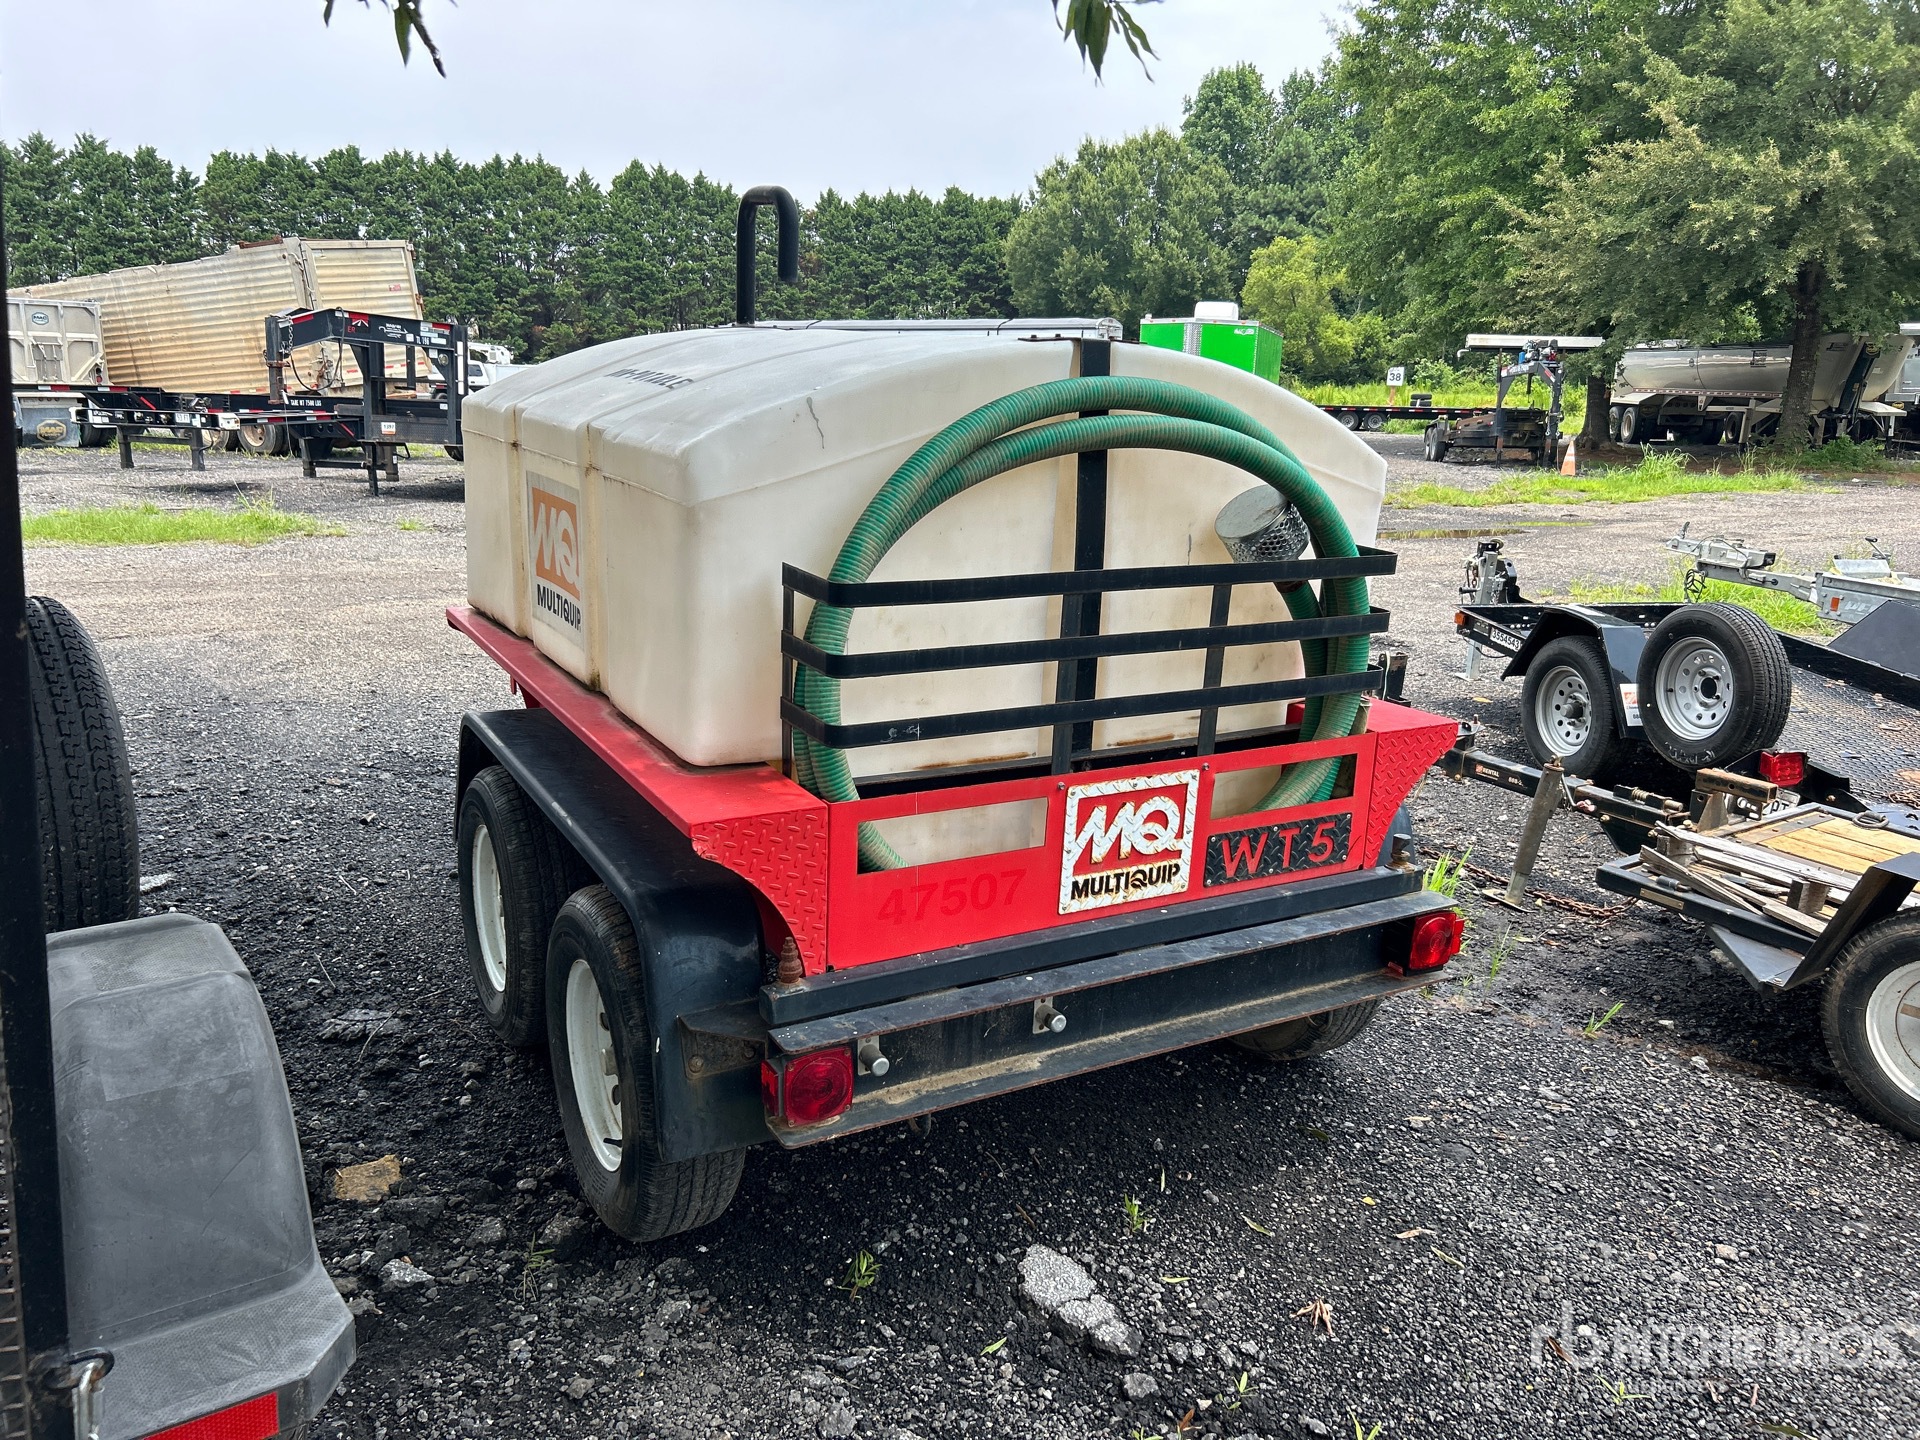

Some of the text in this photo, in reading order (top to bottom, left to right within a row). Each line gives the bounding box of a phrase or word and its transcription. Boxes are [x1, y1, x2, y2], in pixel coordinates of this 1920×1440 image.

[1389, 372, 1402, 382] 38
[536, 583, 582, 633] MULTIQUIP
[1073, 795, 1183, 865] MQ
[877, 868, 1028, 923] 47507
[1071, 863, 1181, 900] MULTIQUIP
